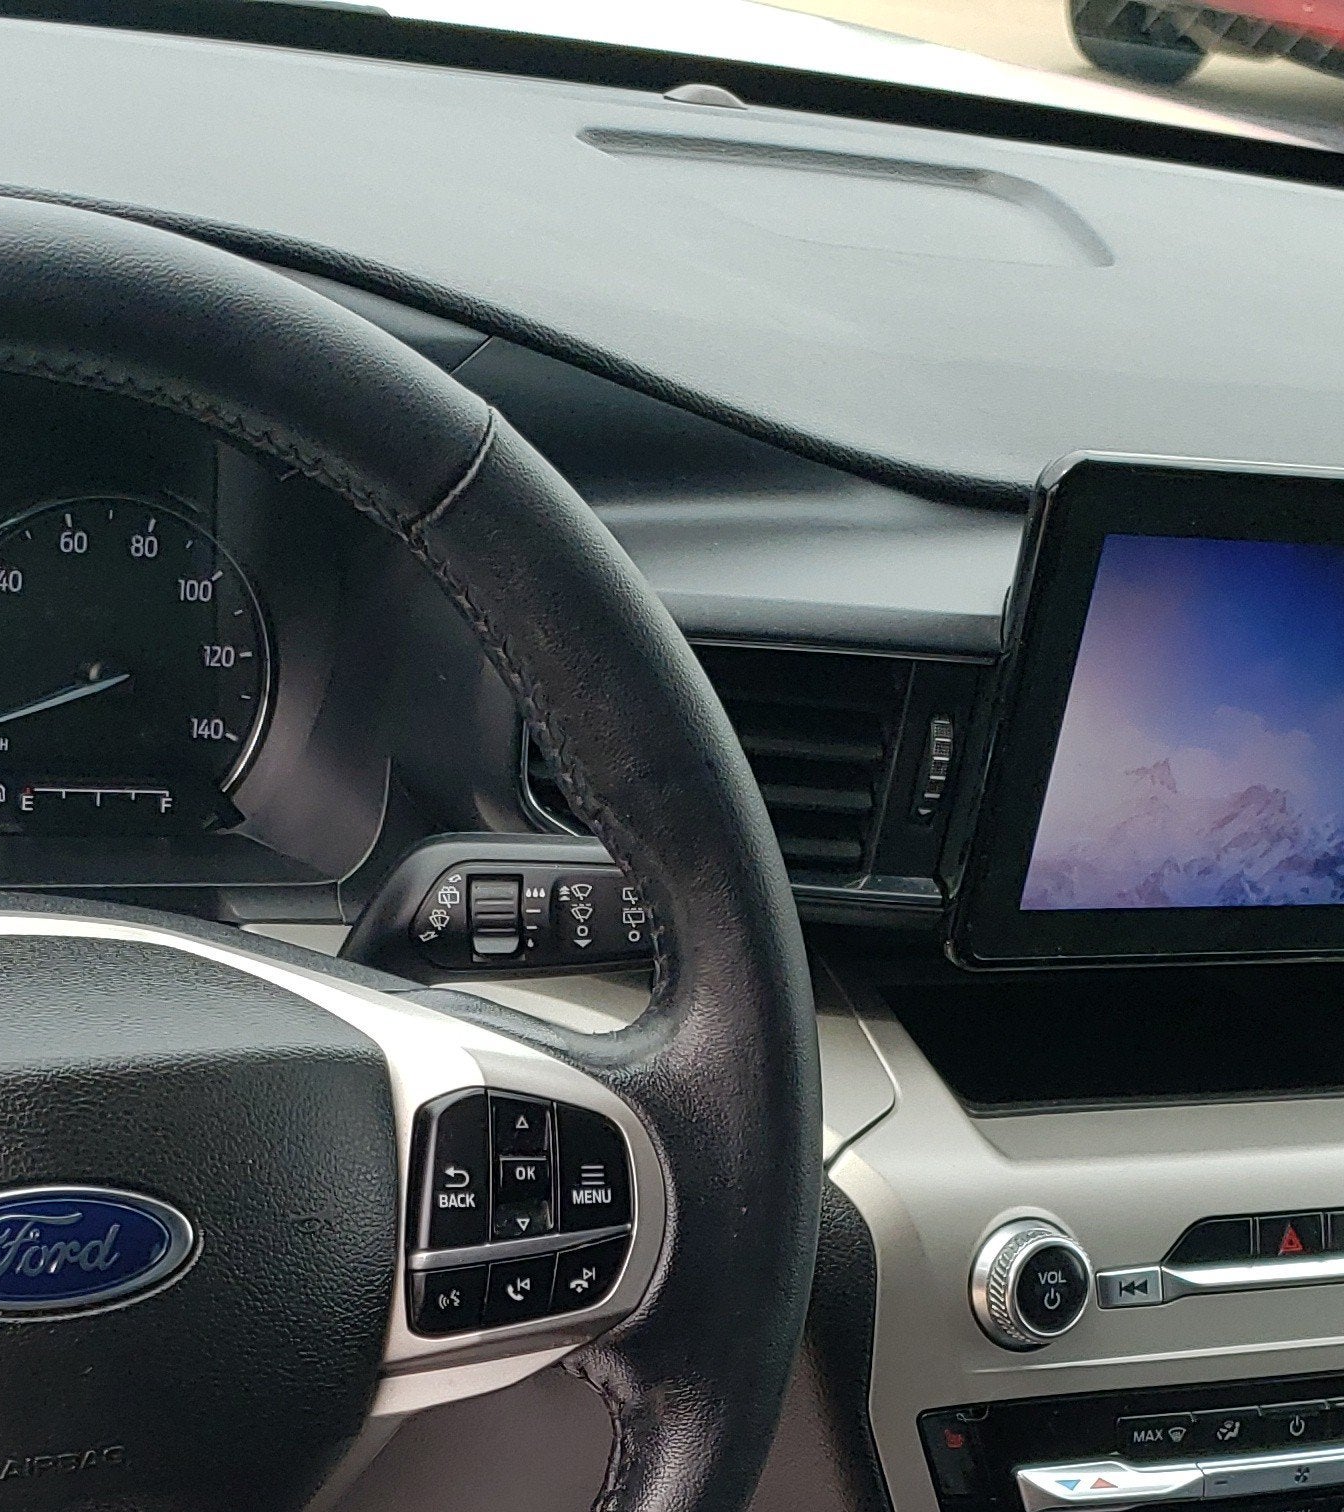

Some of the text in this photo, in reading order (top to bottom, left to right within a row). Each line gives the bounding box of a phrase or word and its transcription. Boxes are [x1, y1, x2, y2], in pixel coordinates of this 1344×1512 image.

[60, 531, 88, 554] 60
[130, 536, 158, 558] 80
[178, 580, 213, 602] 100
[204, 646, 236, 668] 120
[191, 719, 225, 740] 140
[21, 796, 34, 811] E
[160, 798, 172, 813] F
[515, 1166, 536, 1181] OK
[439, 1194, 476, 1209] BACK
[572, 1189, 612, 1205] MENU
[1038, 1270, 1067, 1286] VOL
[1133, 1428, 1164, 1444] MAX
